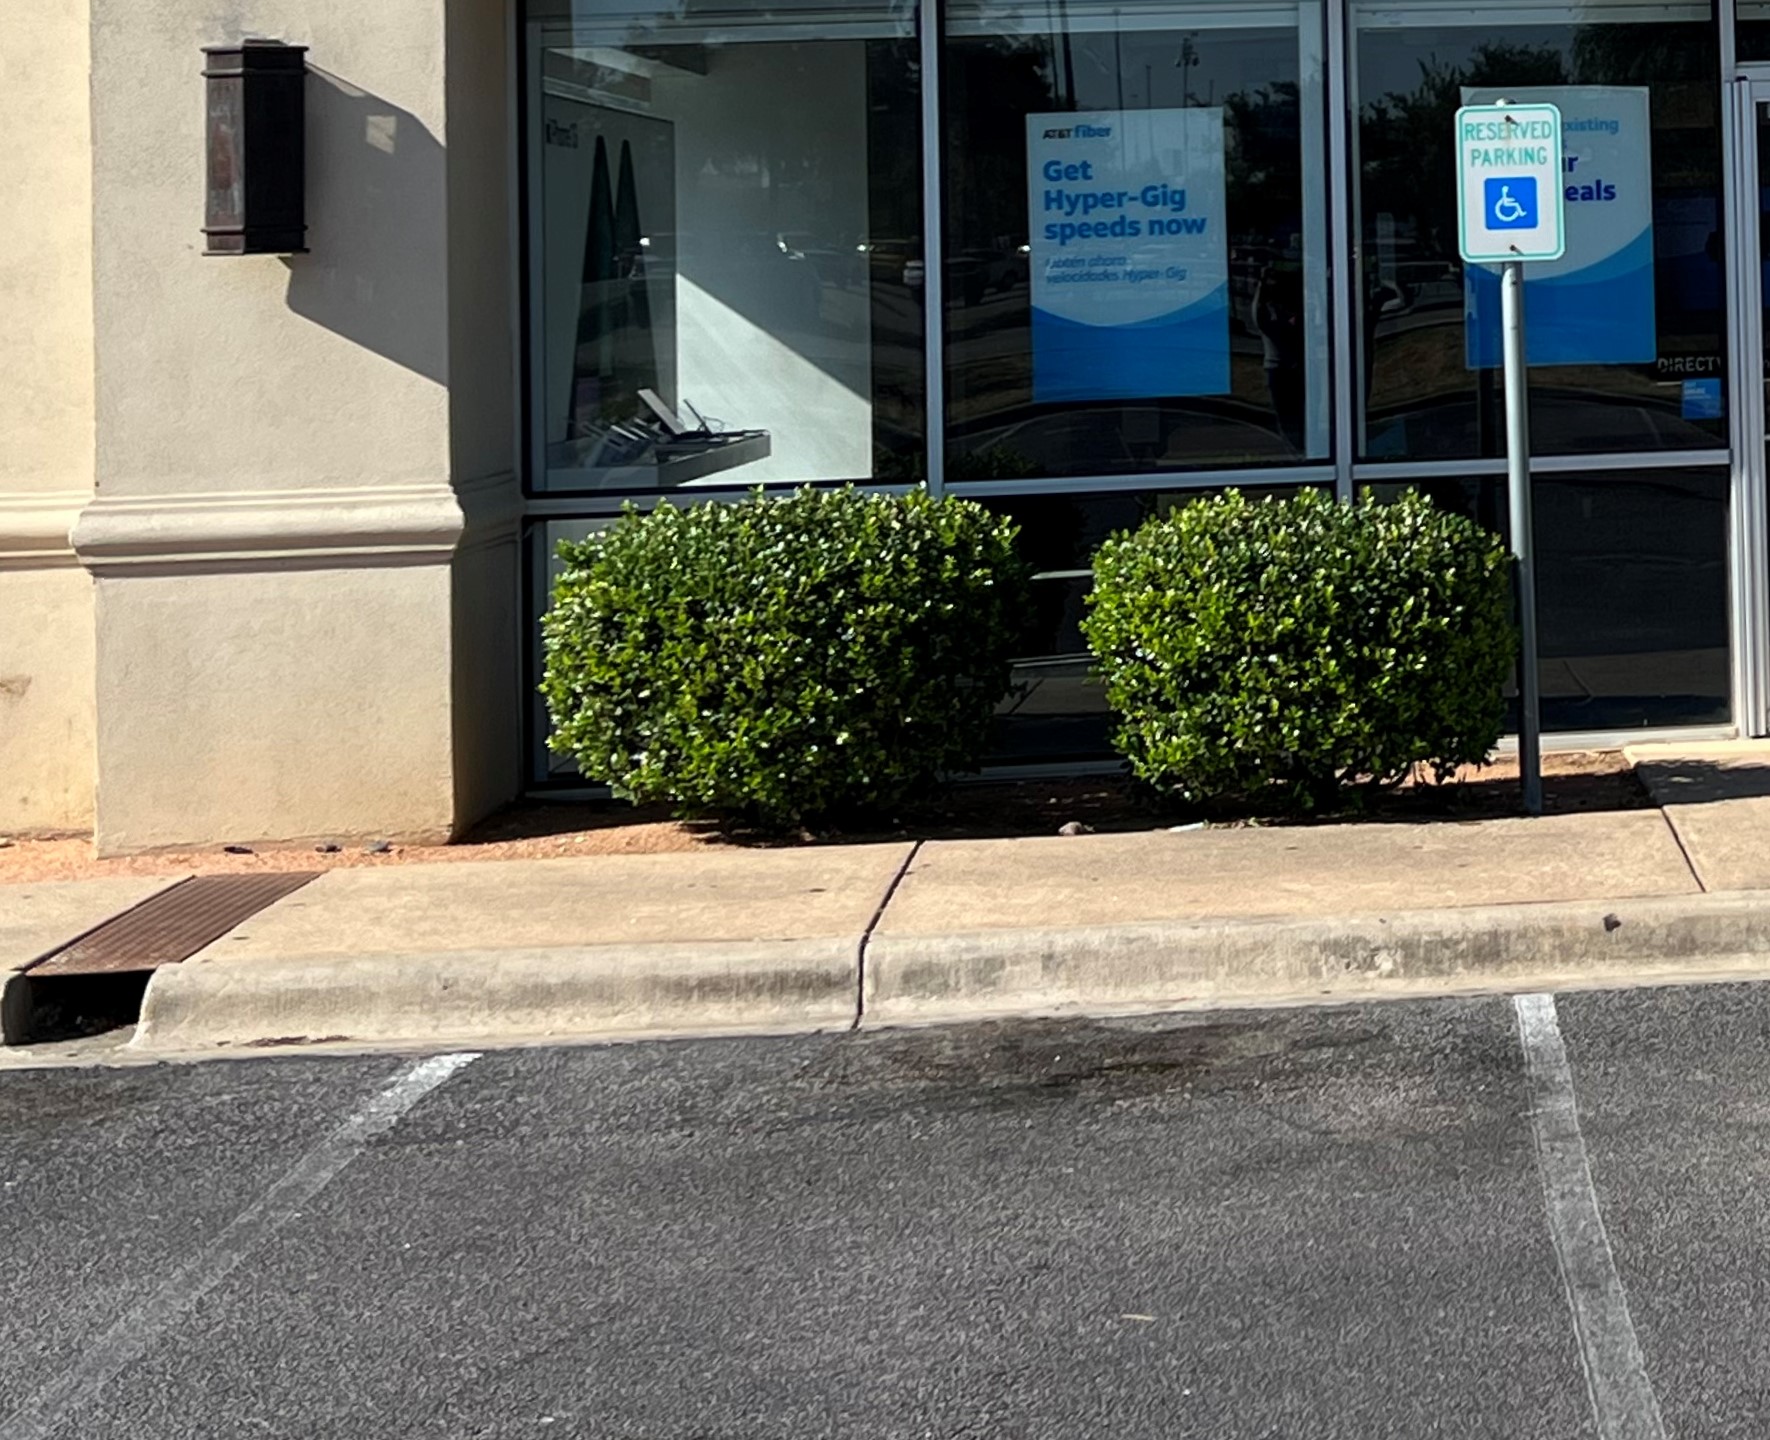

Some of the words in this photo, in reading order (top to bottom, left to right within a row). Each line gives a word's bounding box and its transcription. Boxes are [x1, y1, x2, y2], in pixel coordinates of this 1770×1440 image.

[1074, 125, 1112, 139] fiber
[1464, 120, 1552, 142] RESERVED
[1565, 117, 1619, 135] xisting
[1470, 146, 1548, 168] PARKING
[1043, 160, 1093, 182] Get
[1044, 183, 1186, 216] Hyper-Gig
[1564, 179, 1616, 201] eals
[1044, 214, 1141, 246] speeds
[1148, 217, 1207, 236] now
